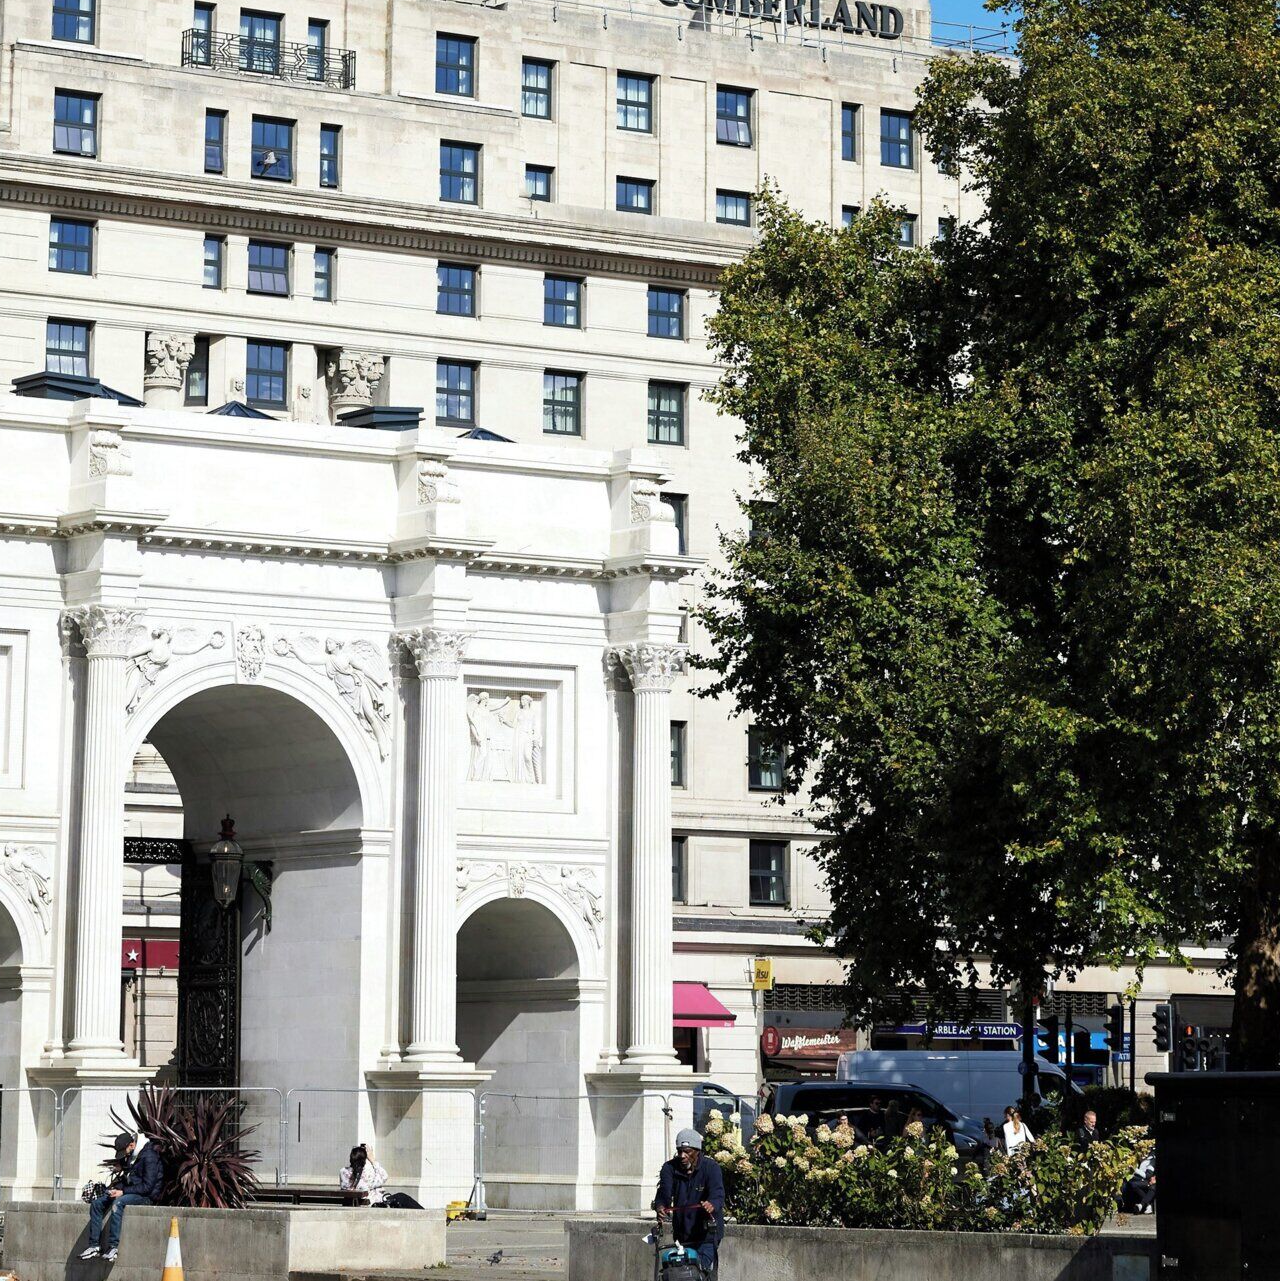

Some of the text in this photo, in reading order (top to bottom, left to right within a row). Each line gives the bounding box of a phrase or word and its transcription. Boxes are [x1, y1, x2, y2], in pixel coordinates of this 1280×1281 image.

[756, 968, 769, 979] itsu
[926, 1025, 957, 1035] ARBLE
[983, 1026, 1017, 1035] STATION
[781, 1034, 840, 1051] Wafflemeister
